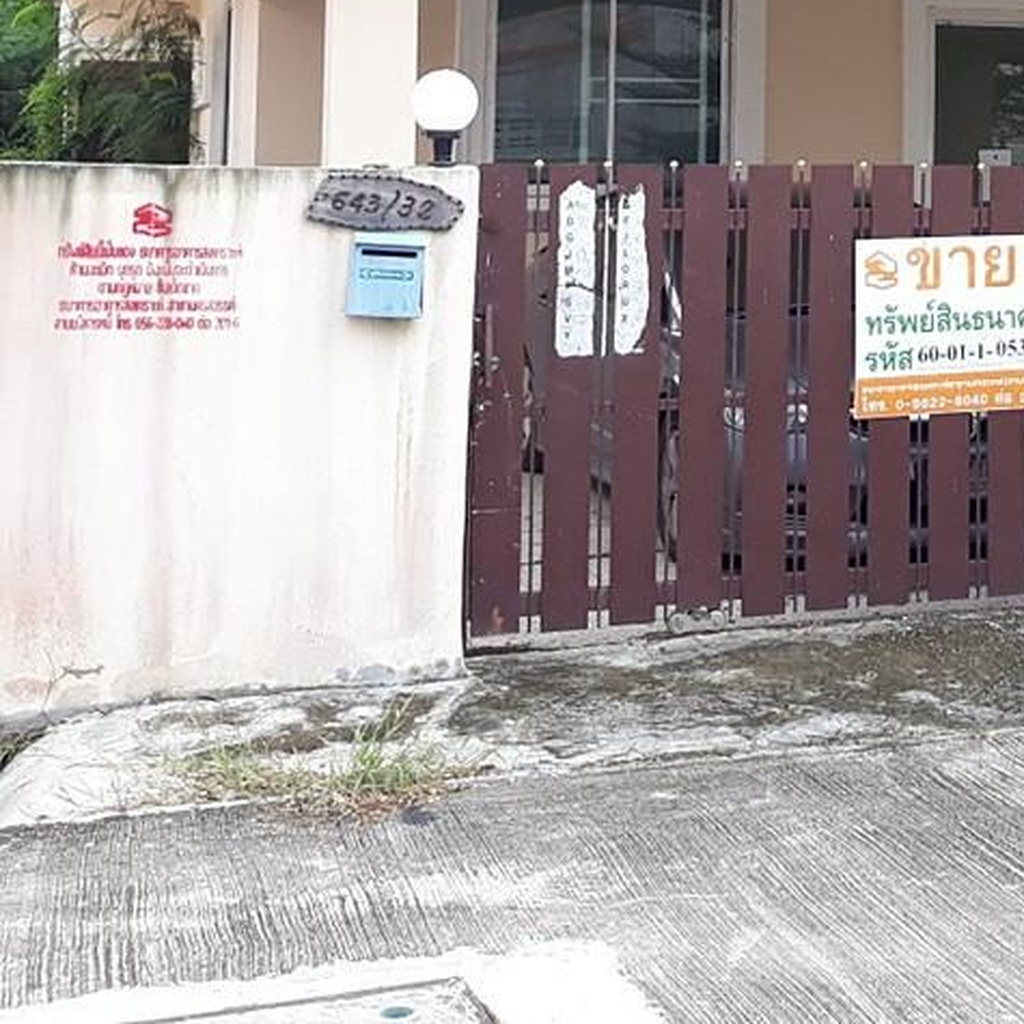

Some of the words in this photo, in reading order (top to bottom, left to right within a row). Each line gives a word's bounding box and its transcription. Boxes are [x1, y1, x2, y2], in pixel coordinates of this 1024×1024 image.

[331, 190, 435, 222] 643/32
[906, 243, 1016, 291] ขาย
[865, 341, 913, 372] รหัส
